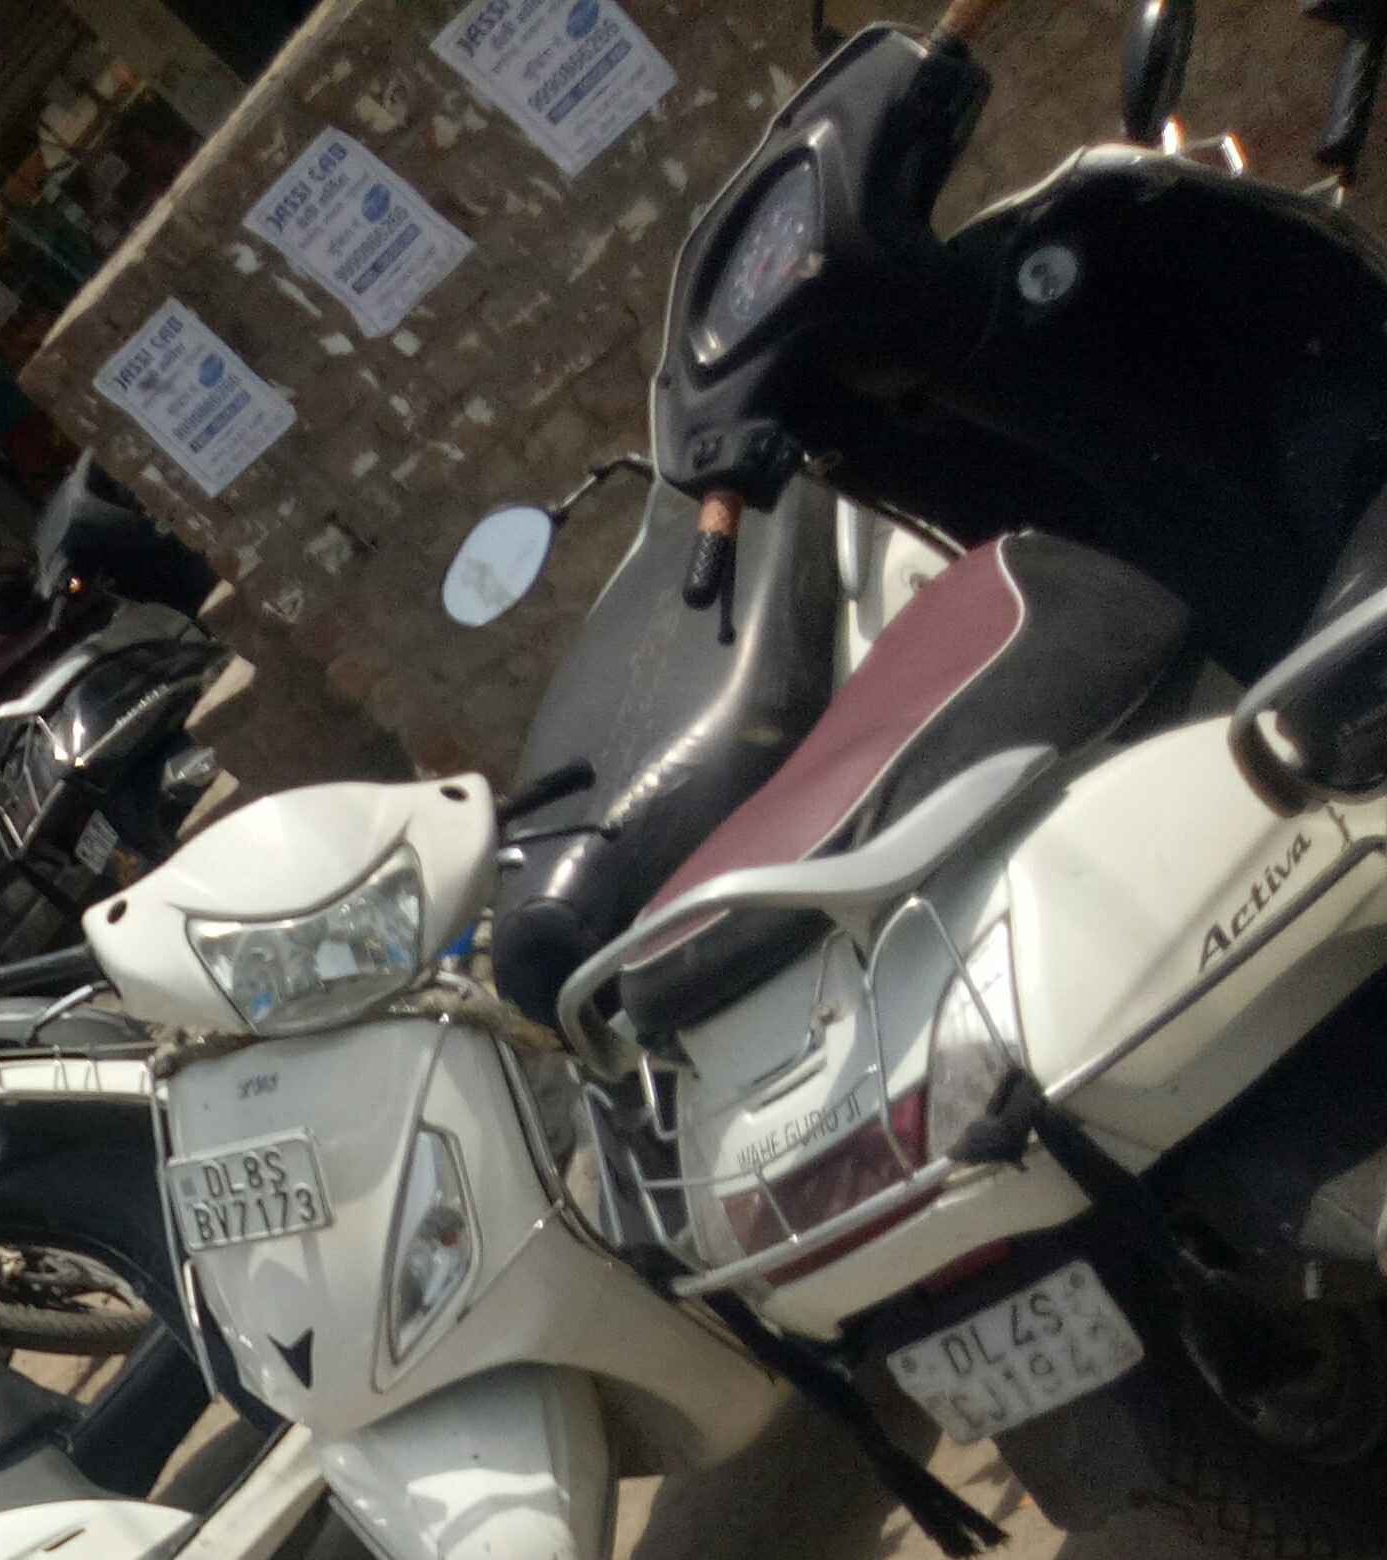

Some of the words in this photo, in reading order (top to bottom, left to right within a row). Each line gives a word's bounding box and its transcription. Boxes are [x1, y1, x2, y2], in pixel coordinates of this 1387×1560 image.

[305, 139, 349, 186] CAB
[147, 313, 185, 351] CAB
[1199, 833, 1312, 974] Activa
[193, 1188, 316, 1241] BV7173
